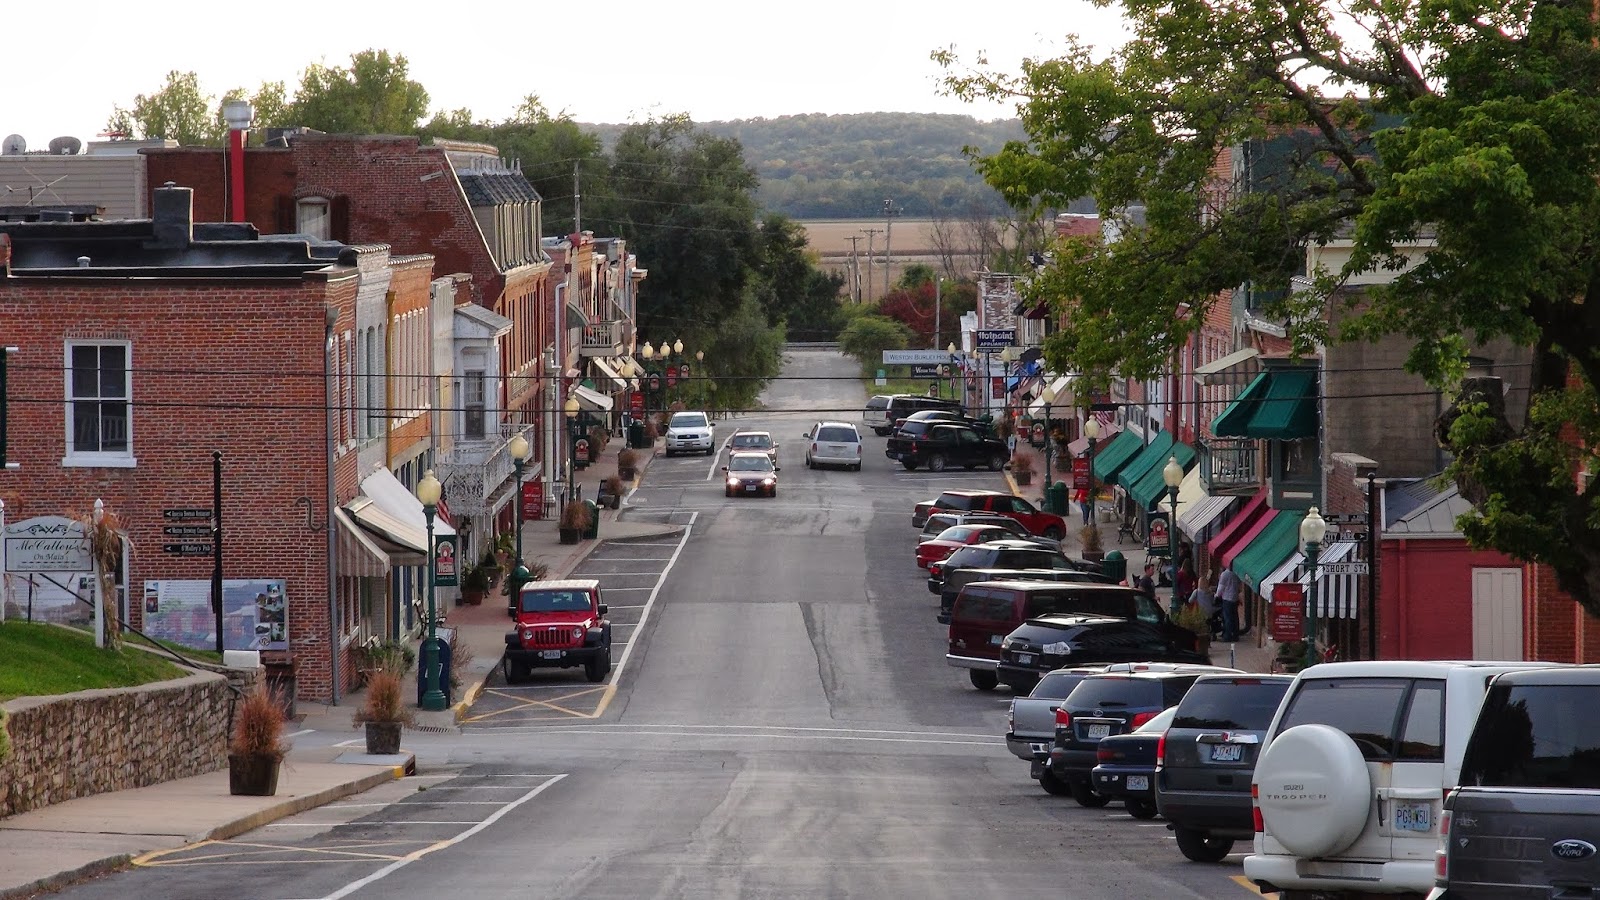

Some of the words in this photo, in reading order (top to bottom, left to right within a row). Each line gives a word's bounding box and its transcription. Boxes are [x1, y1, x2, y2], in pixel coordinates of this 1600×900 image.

[978, 331, 1014, 343] Hotpoint
[46, 552, 64, 560] Main
[1325, 564, 1349, 573] SHORT
[1558, 842, 1584, 857] Ford
